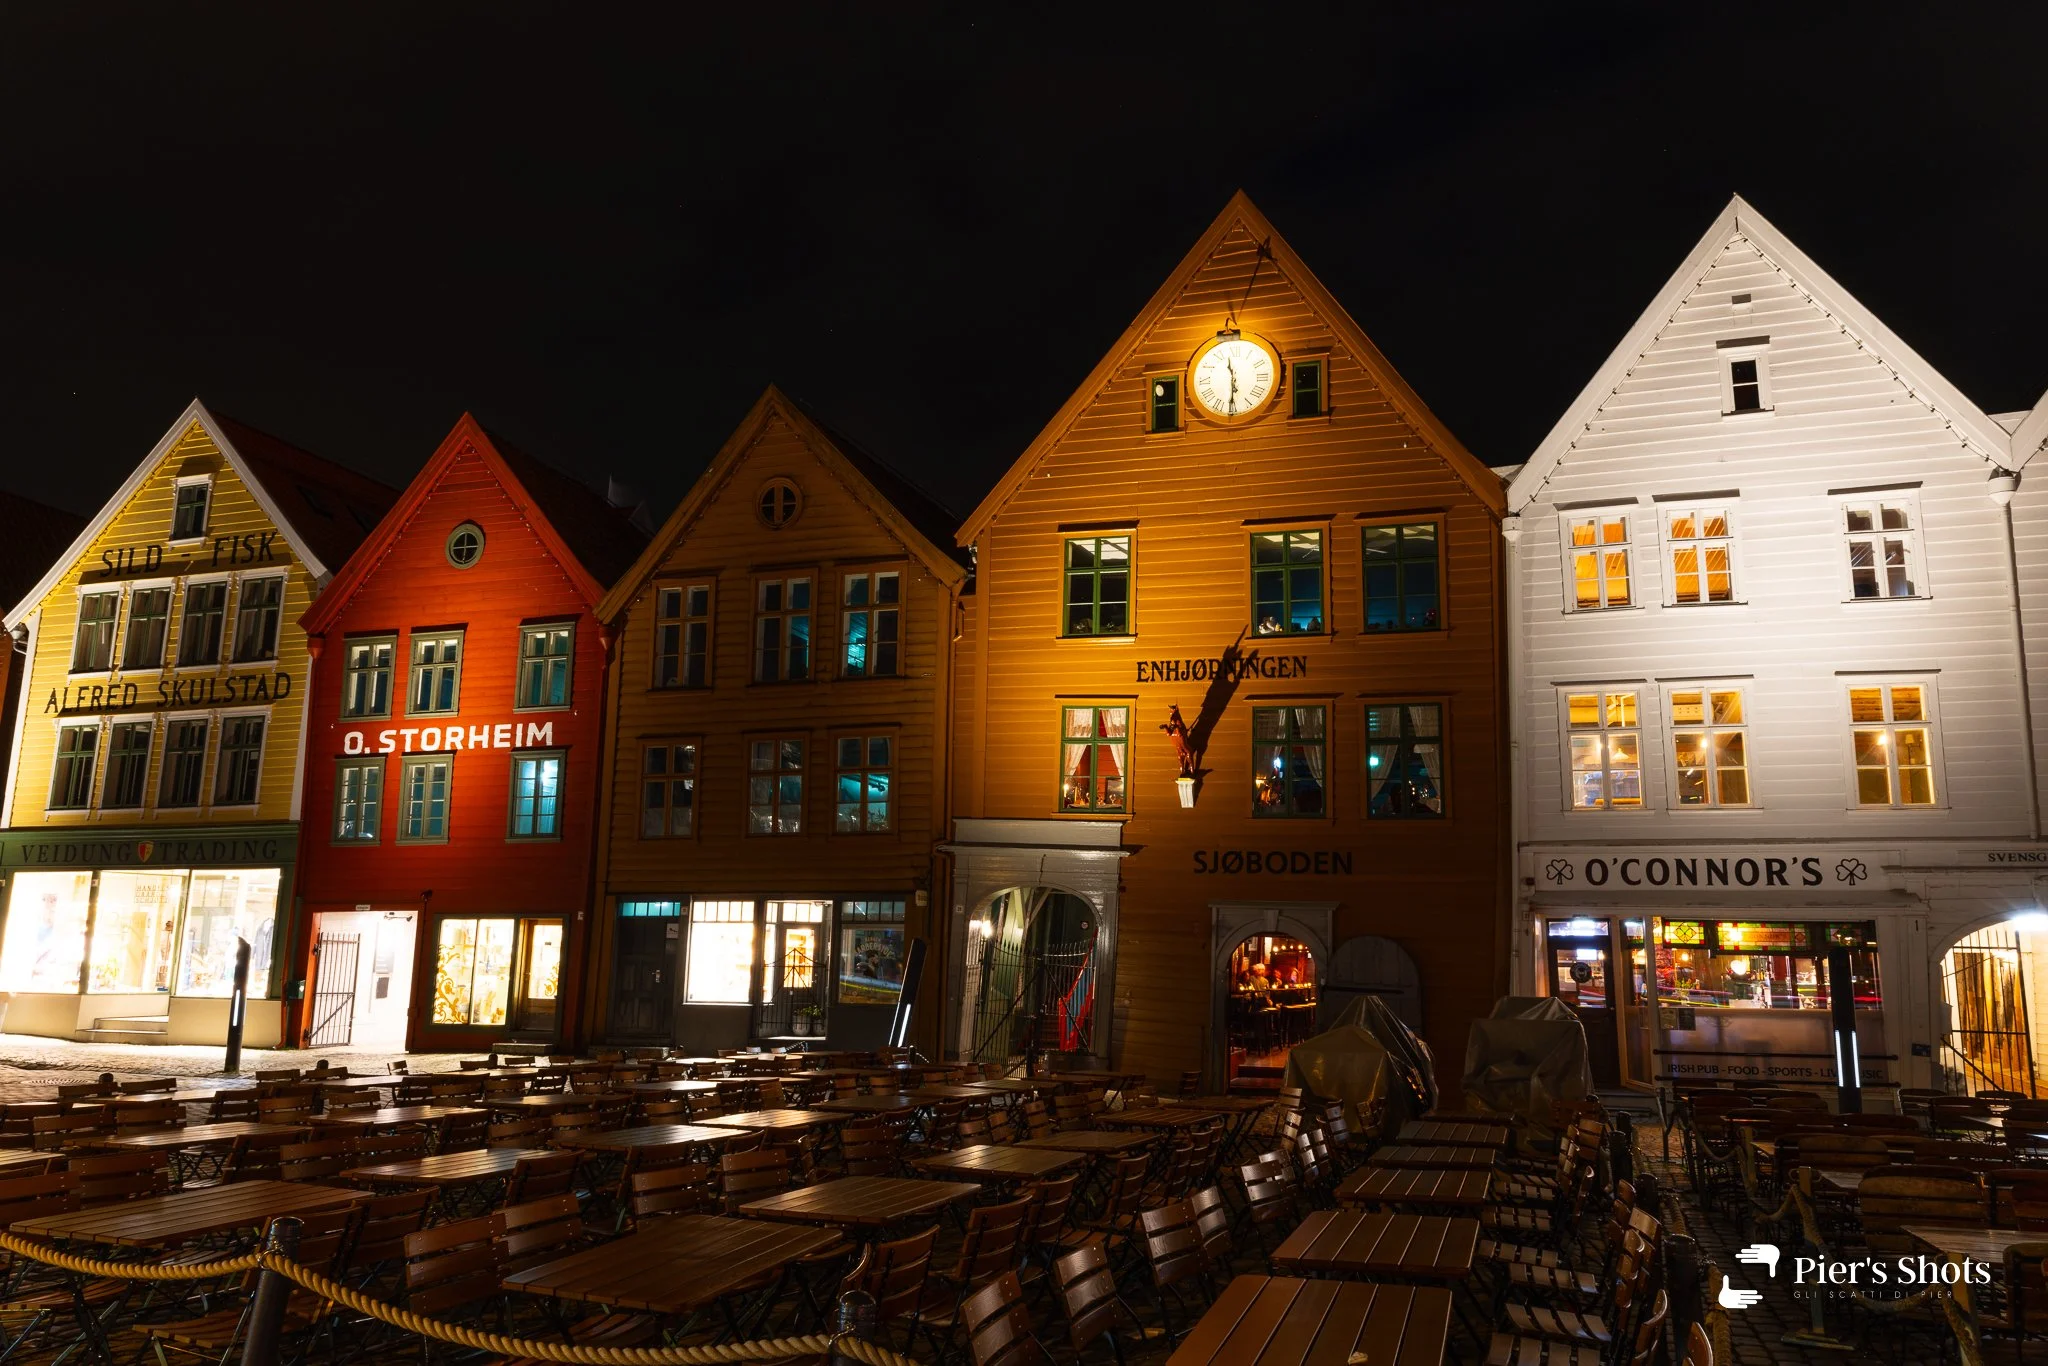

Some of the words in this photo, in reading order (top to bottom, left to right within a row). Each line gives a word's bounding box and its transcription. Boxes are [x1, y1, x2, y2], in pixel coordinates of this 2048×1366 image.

[100, 545, 163, 577] SILD
[212, 532, 277, 567] FISK
[1136, 655, 1308, 683] ENHJØRNINGEN
[44, 682, 138, 715] ALFRED
[158, 672, 292, 709] SKULSTAD
[344, 731, 371, 755] O.
[378, 721, 554, 754] STORHEIM
[21, 842, 132, 864] VEIDUNG
[159, 839, 278, 862] TRADING
[1193, 850, 1353, 876] SJØBODEN
[1585, 857, 1823, 887] O'CONNOR'S
[1668, 1064, 1694, 1073] IRISH
[1698, 1065, 1719, 1074] PUB
[1728, 1066, 1759, 1076] FOOD
[1768, 1067, 1812, 1077] SPORTS
[1821, 1069, 1838, 1077] LIV
